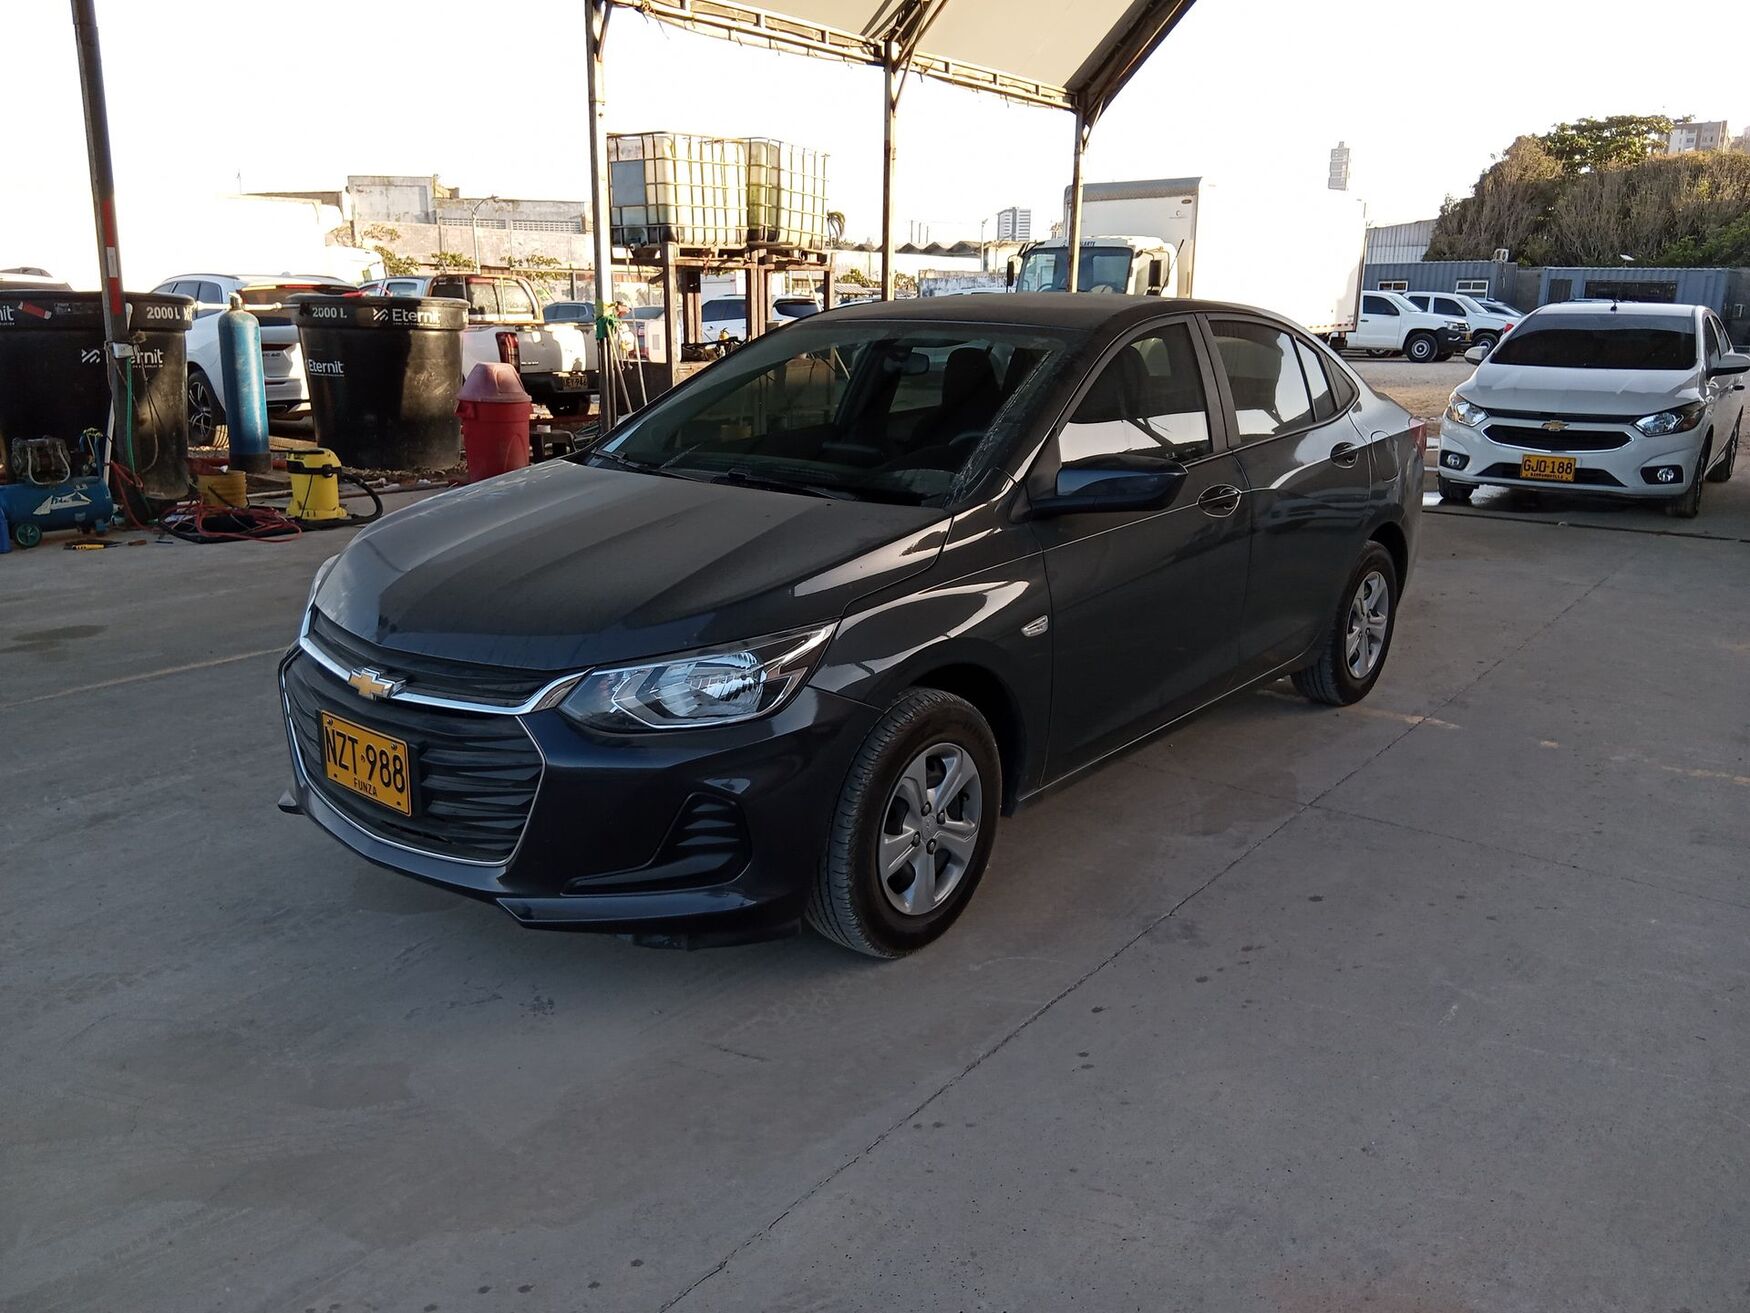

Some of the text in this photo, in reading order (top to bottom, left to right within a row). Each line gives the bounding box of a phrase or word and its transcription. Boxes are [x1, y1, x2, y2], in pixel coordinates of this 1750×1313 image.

[146, 306, 174, 320] 2000
[312, 307, 337, 318] 2000
[392, 308, 441, 323] Eternit
[308, 359, 345, 374] Eternit
[325, 726, 405, 793] NZT 988
[353, 777, 378, 797] FUNZA
